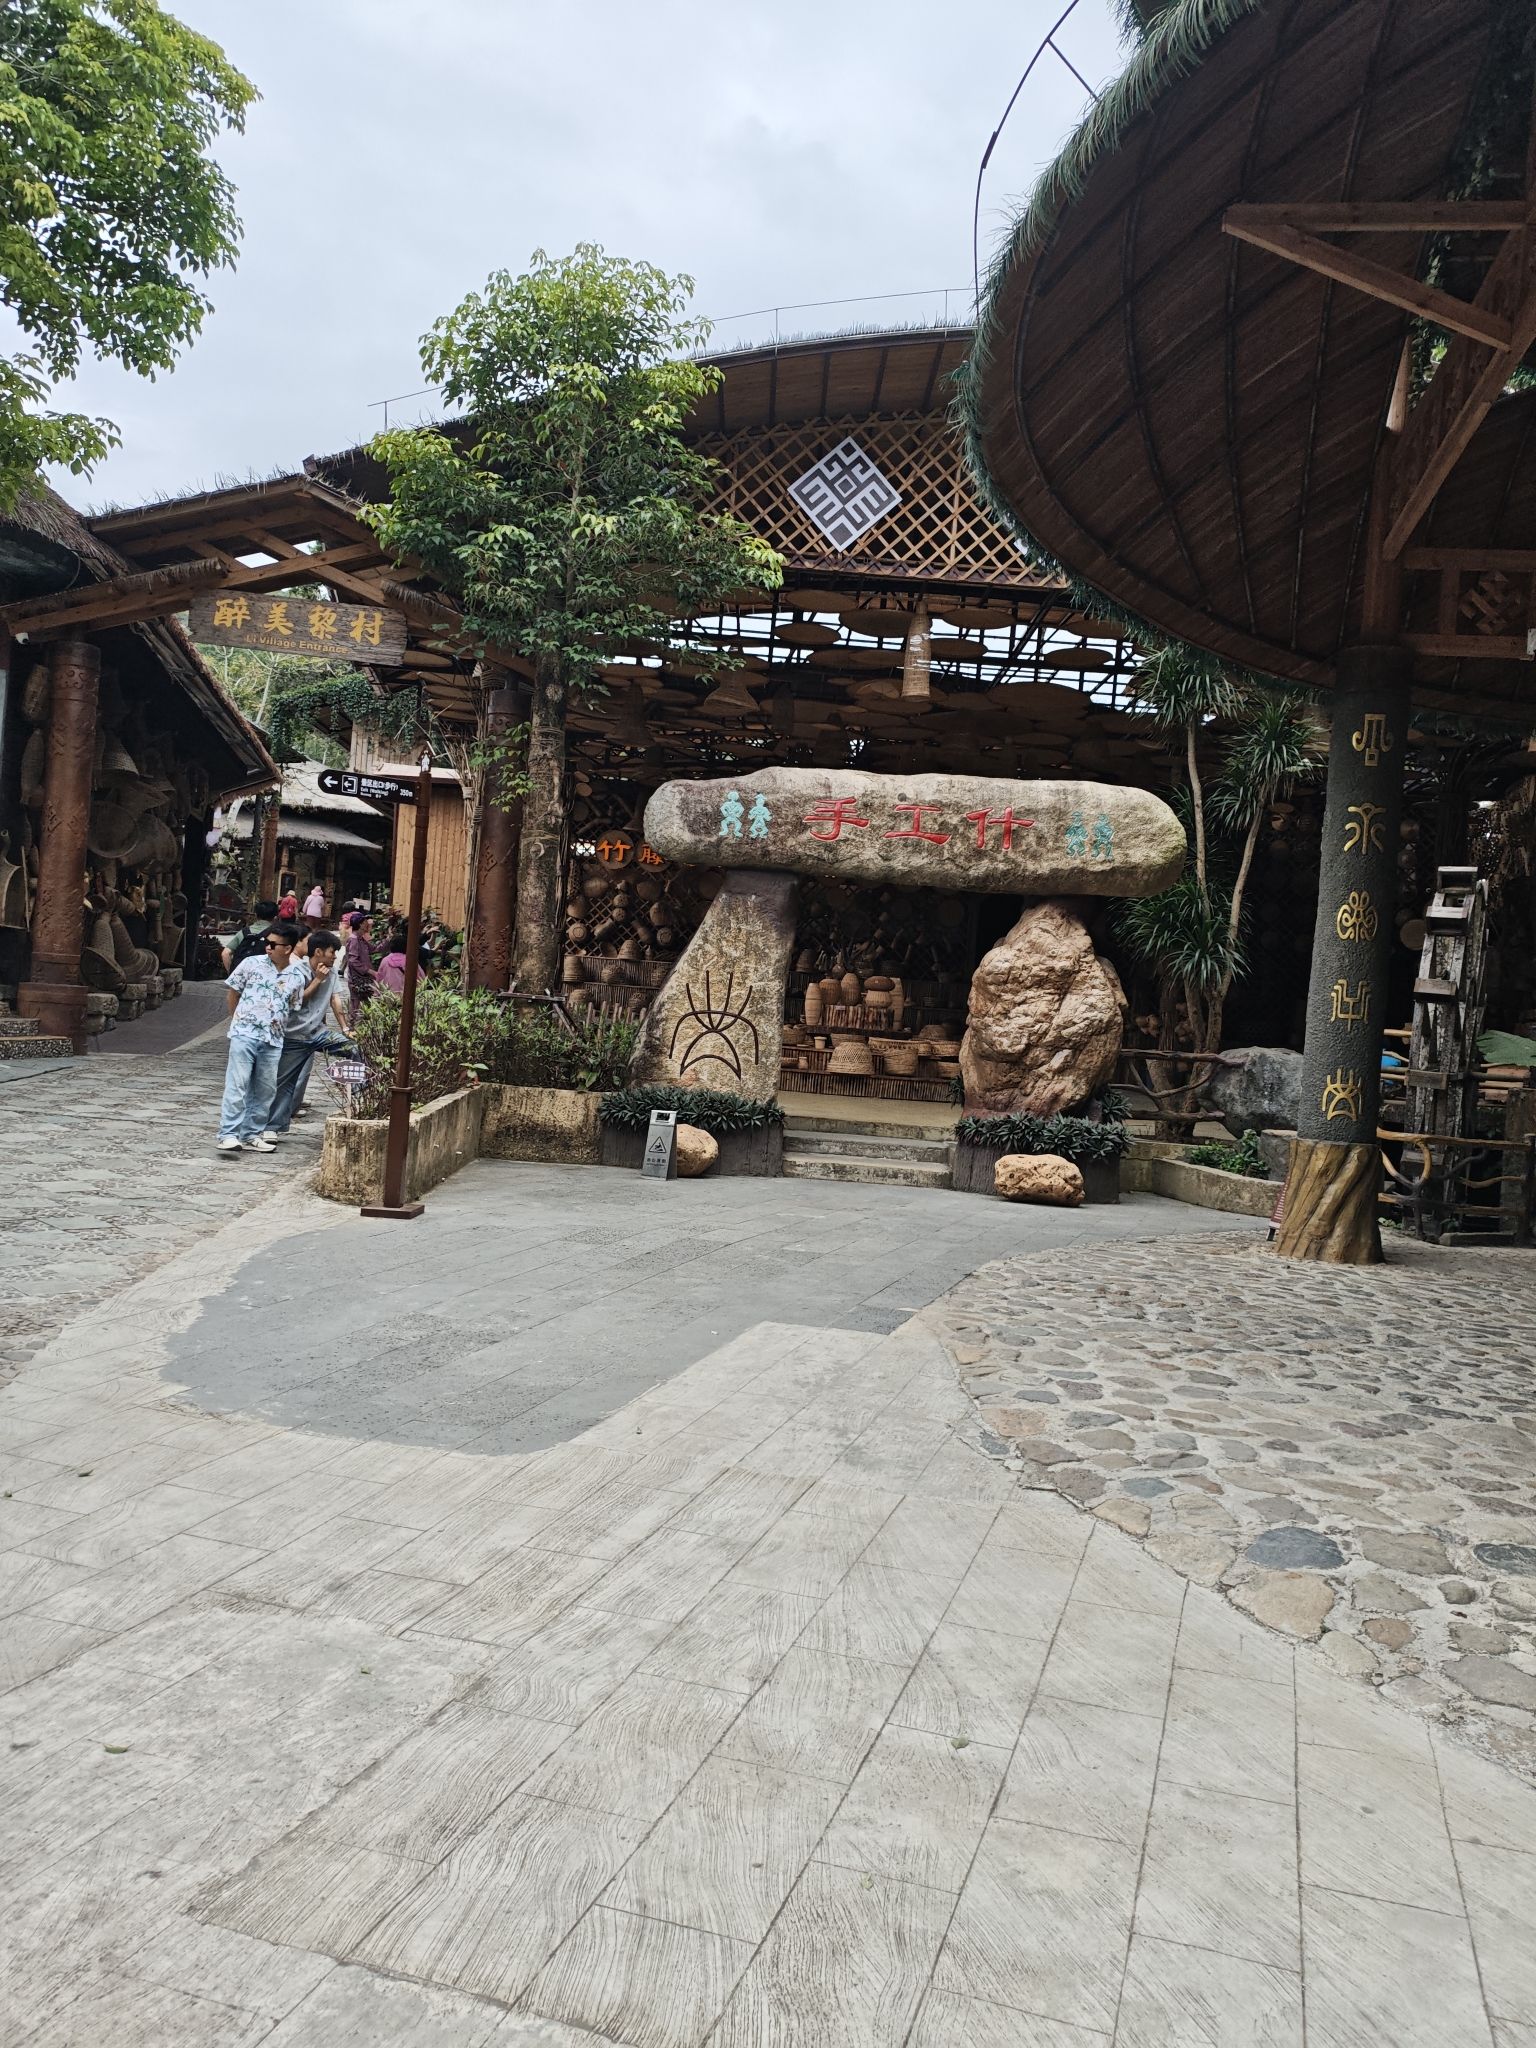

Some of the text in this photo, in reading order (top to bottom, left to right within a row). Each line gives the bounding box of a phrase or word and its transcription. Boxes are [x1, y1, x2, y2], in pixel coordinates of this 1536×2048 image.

[213, 597, 385, 645] 醉美黎村
[246, 634, 349, 654] Li Village Entrance
[803, 797, 1035, 850] 手工什
